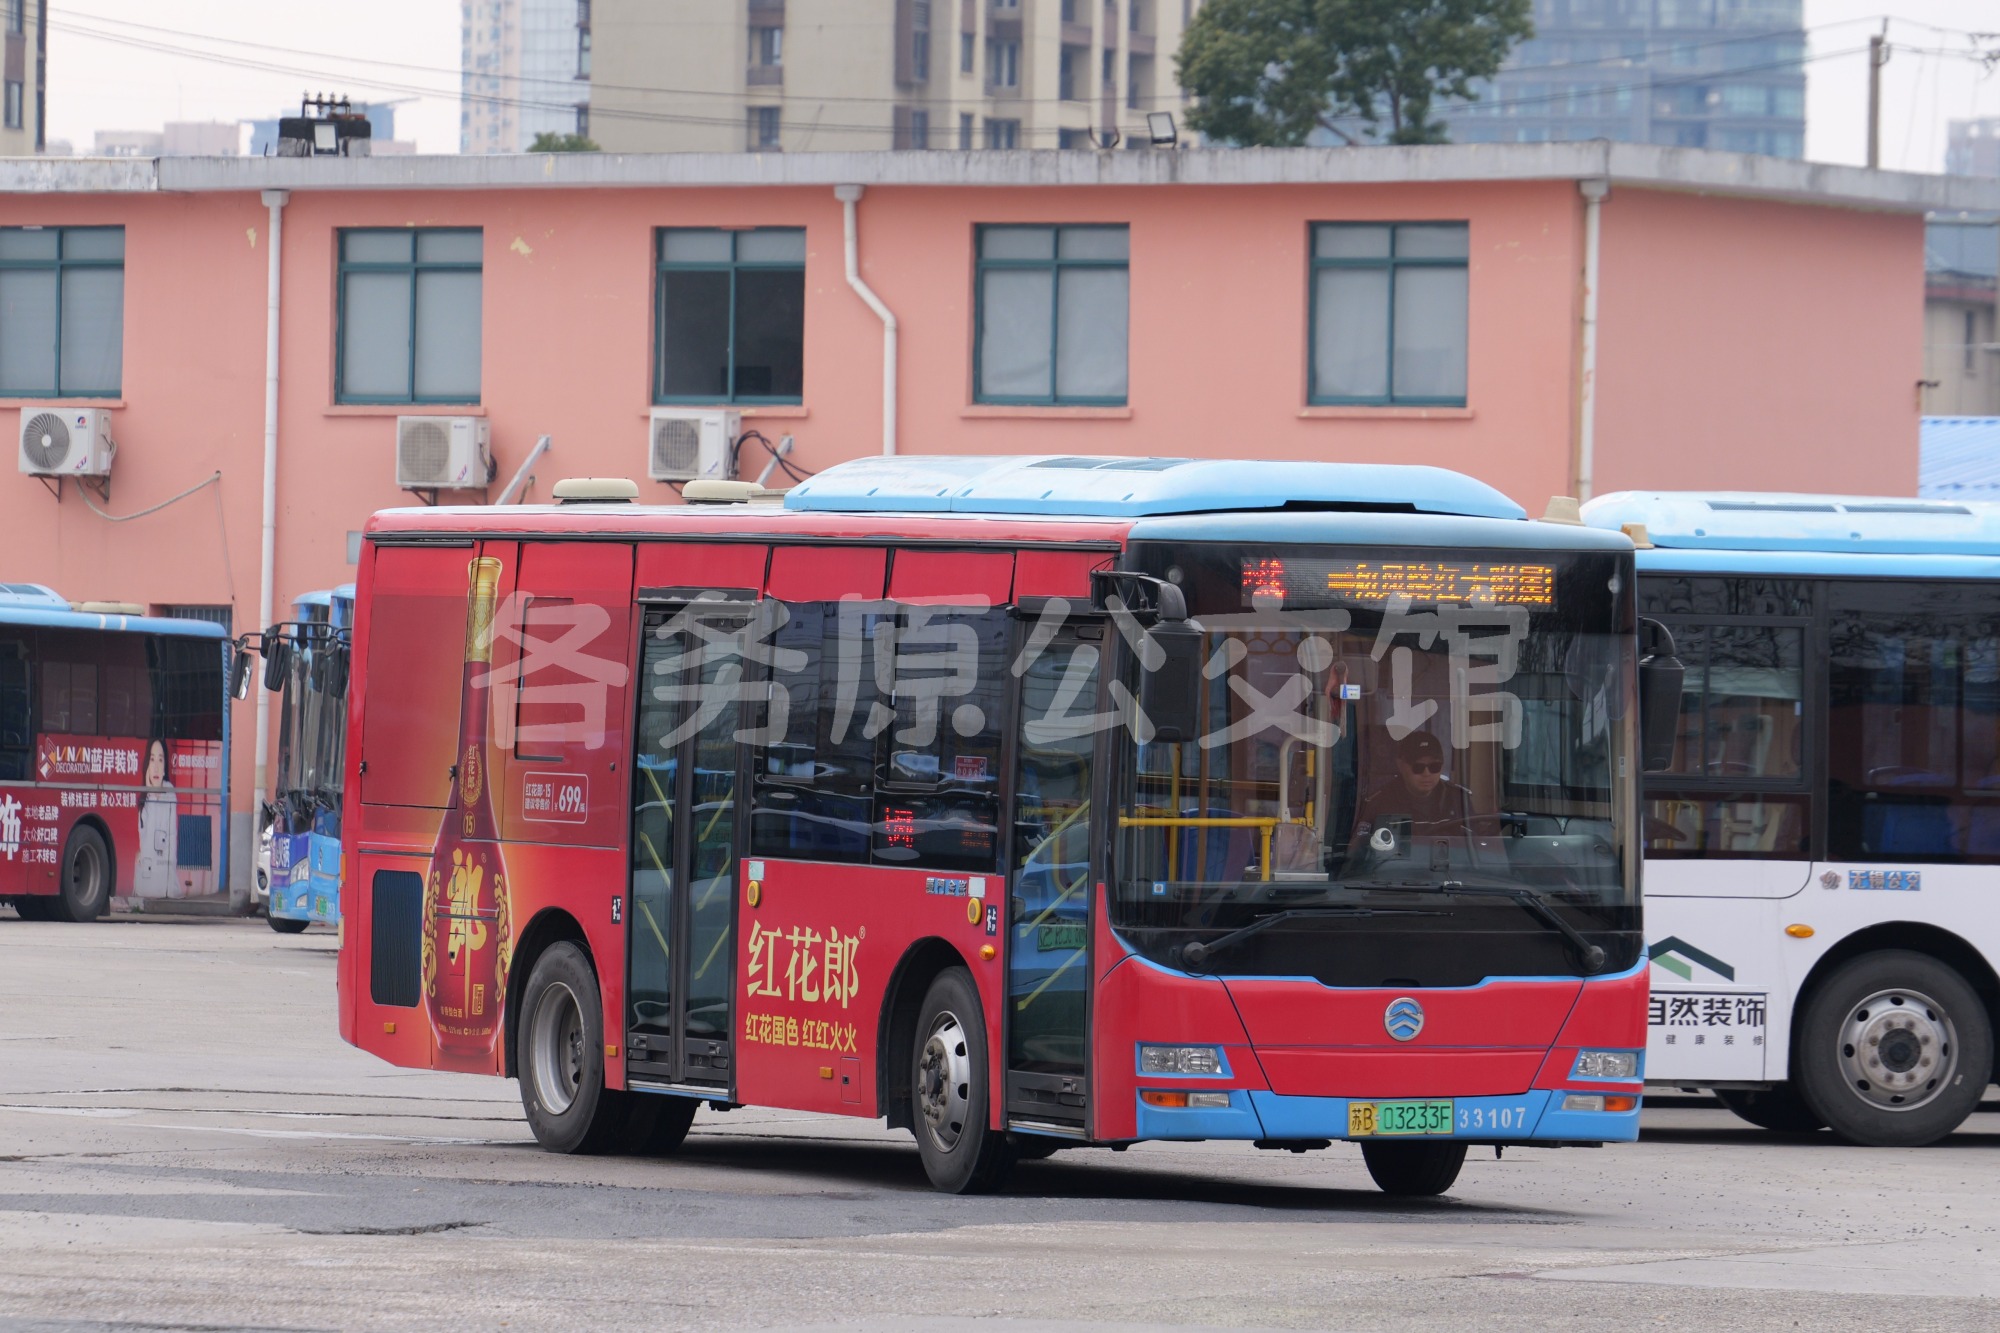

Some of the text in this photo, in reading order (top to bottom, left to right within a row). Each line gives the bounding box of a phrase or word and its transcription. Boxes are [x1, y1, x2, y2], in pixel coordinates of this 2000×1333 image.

[56, 763, 90, 774] DECORATION
[91, 748, 138, 775] 蓝岸装饰
[468, 744, 477, 789] 红花郎
[61, 791, 137, 808] 装修找蓝岸 放心又划算
[25, 805, 59, 820] 本地老品牌
[24, 826, 58, 842] 大众好口碑
[22, 847, 57, 864] 施工不转包
[1850, 871, 1920, 891] 无锡公交
[746, 919, 860, 1009] 红花郎
[1647, 997, 1764, 1027] 自然装饰
[745, 1012, 857, 1053] 红花国色 红红火火
[1665, 1034, 1763, 1046] 健康装修
[1459, 1107, 1526, 1129] 33107
